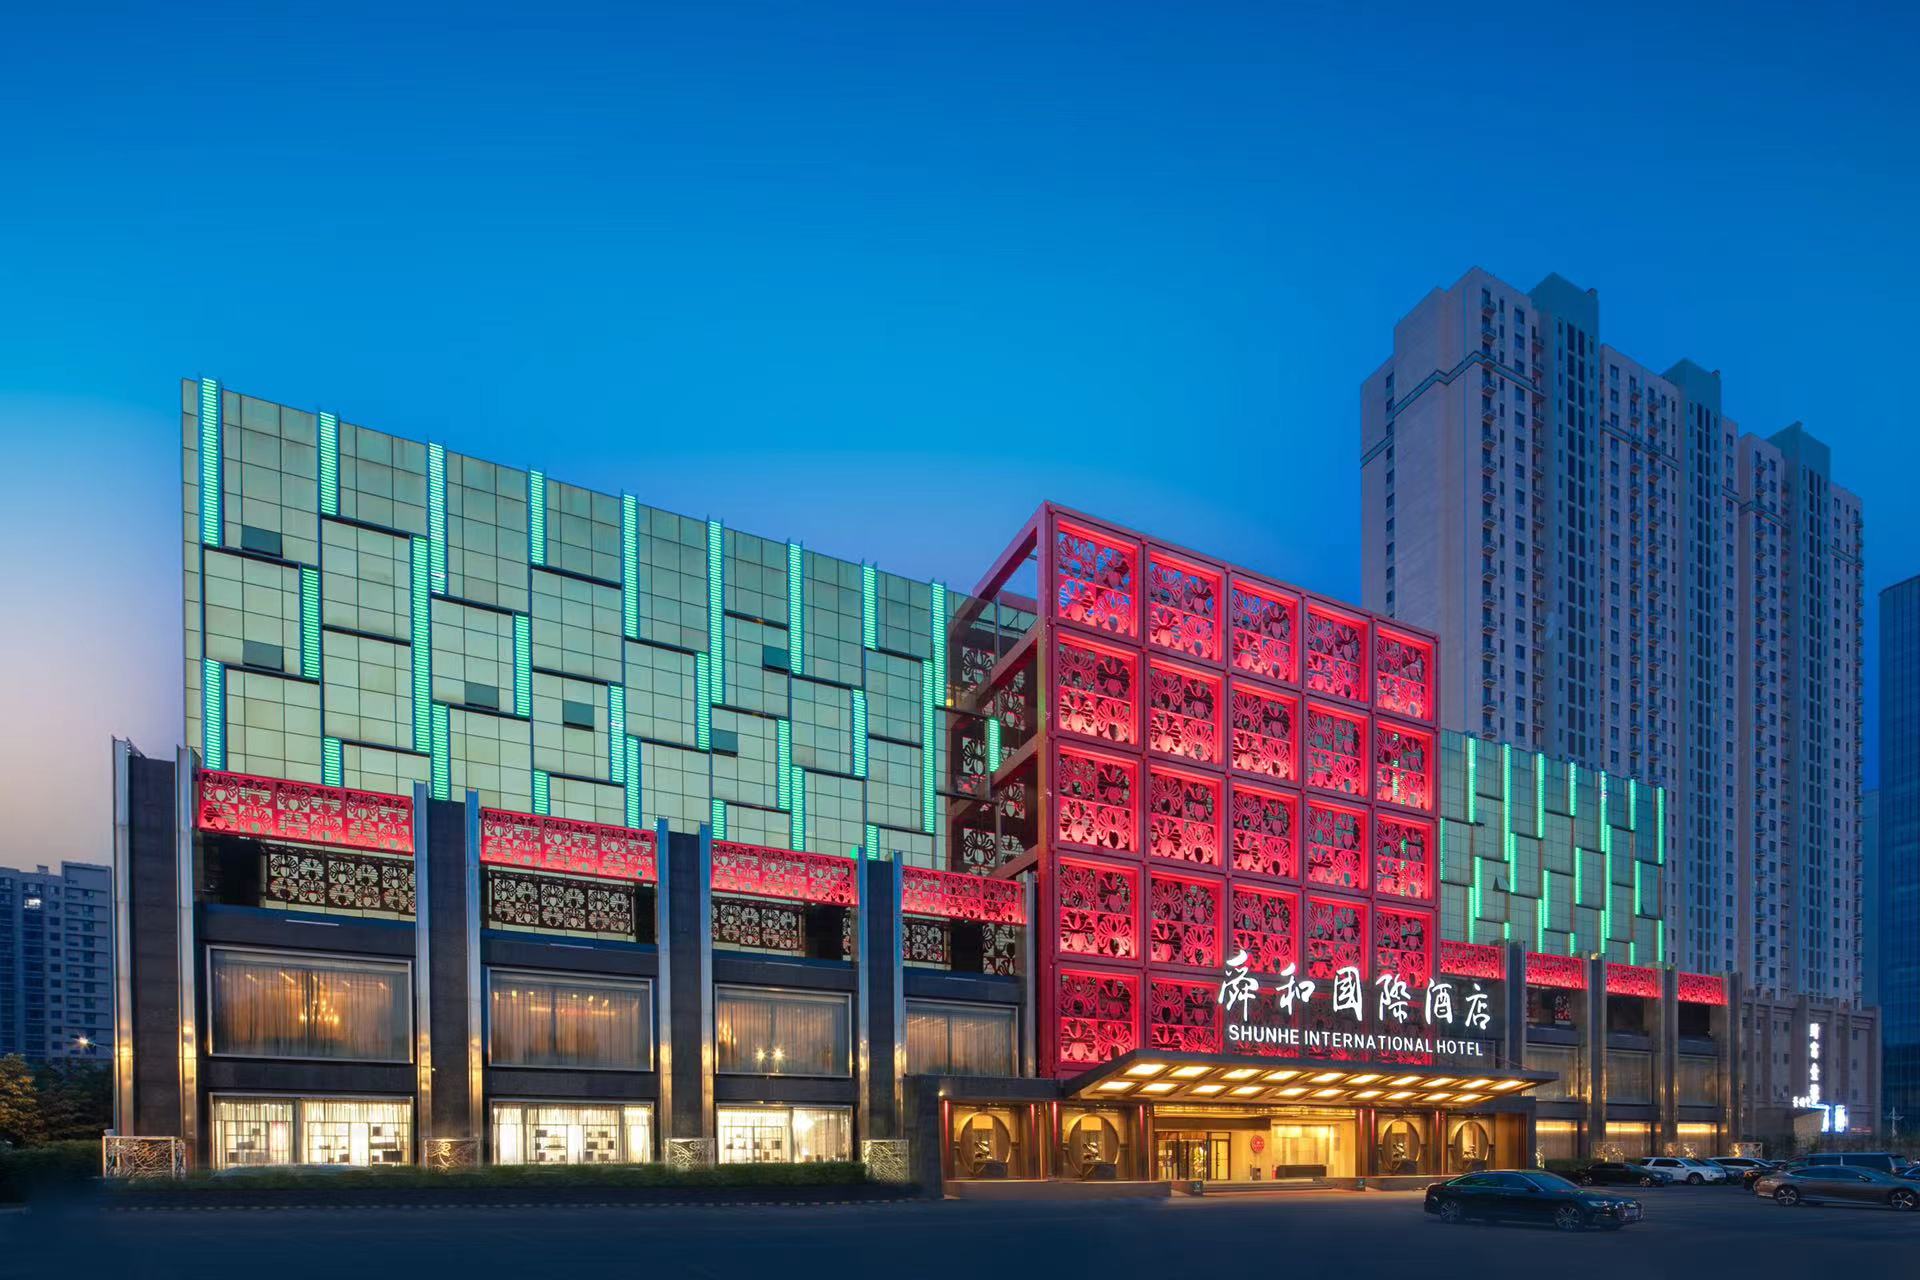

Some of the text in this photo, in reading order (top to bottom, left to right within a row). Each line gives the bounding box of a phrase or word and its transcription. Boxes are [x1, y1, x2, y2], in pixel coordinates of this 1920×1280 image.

[1218, 950, 1491, 1030] 舜和國際酒店
[1228, 1024, 1484, 1056] SHUNHE INTERNATIONAL HOTEL
